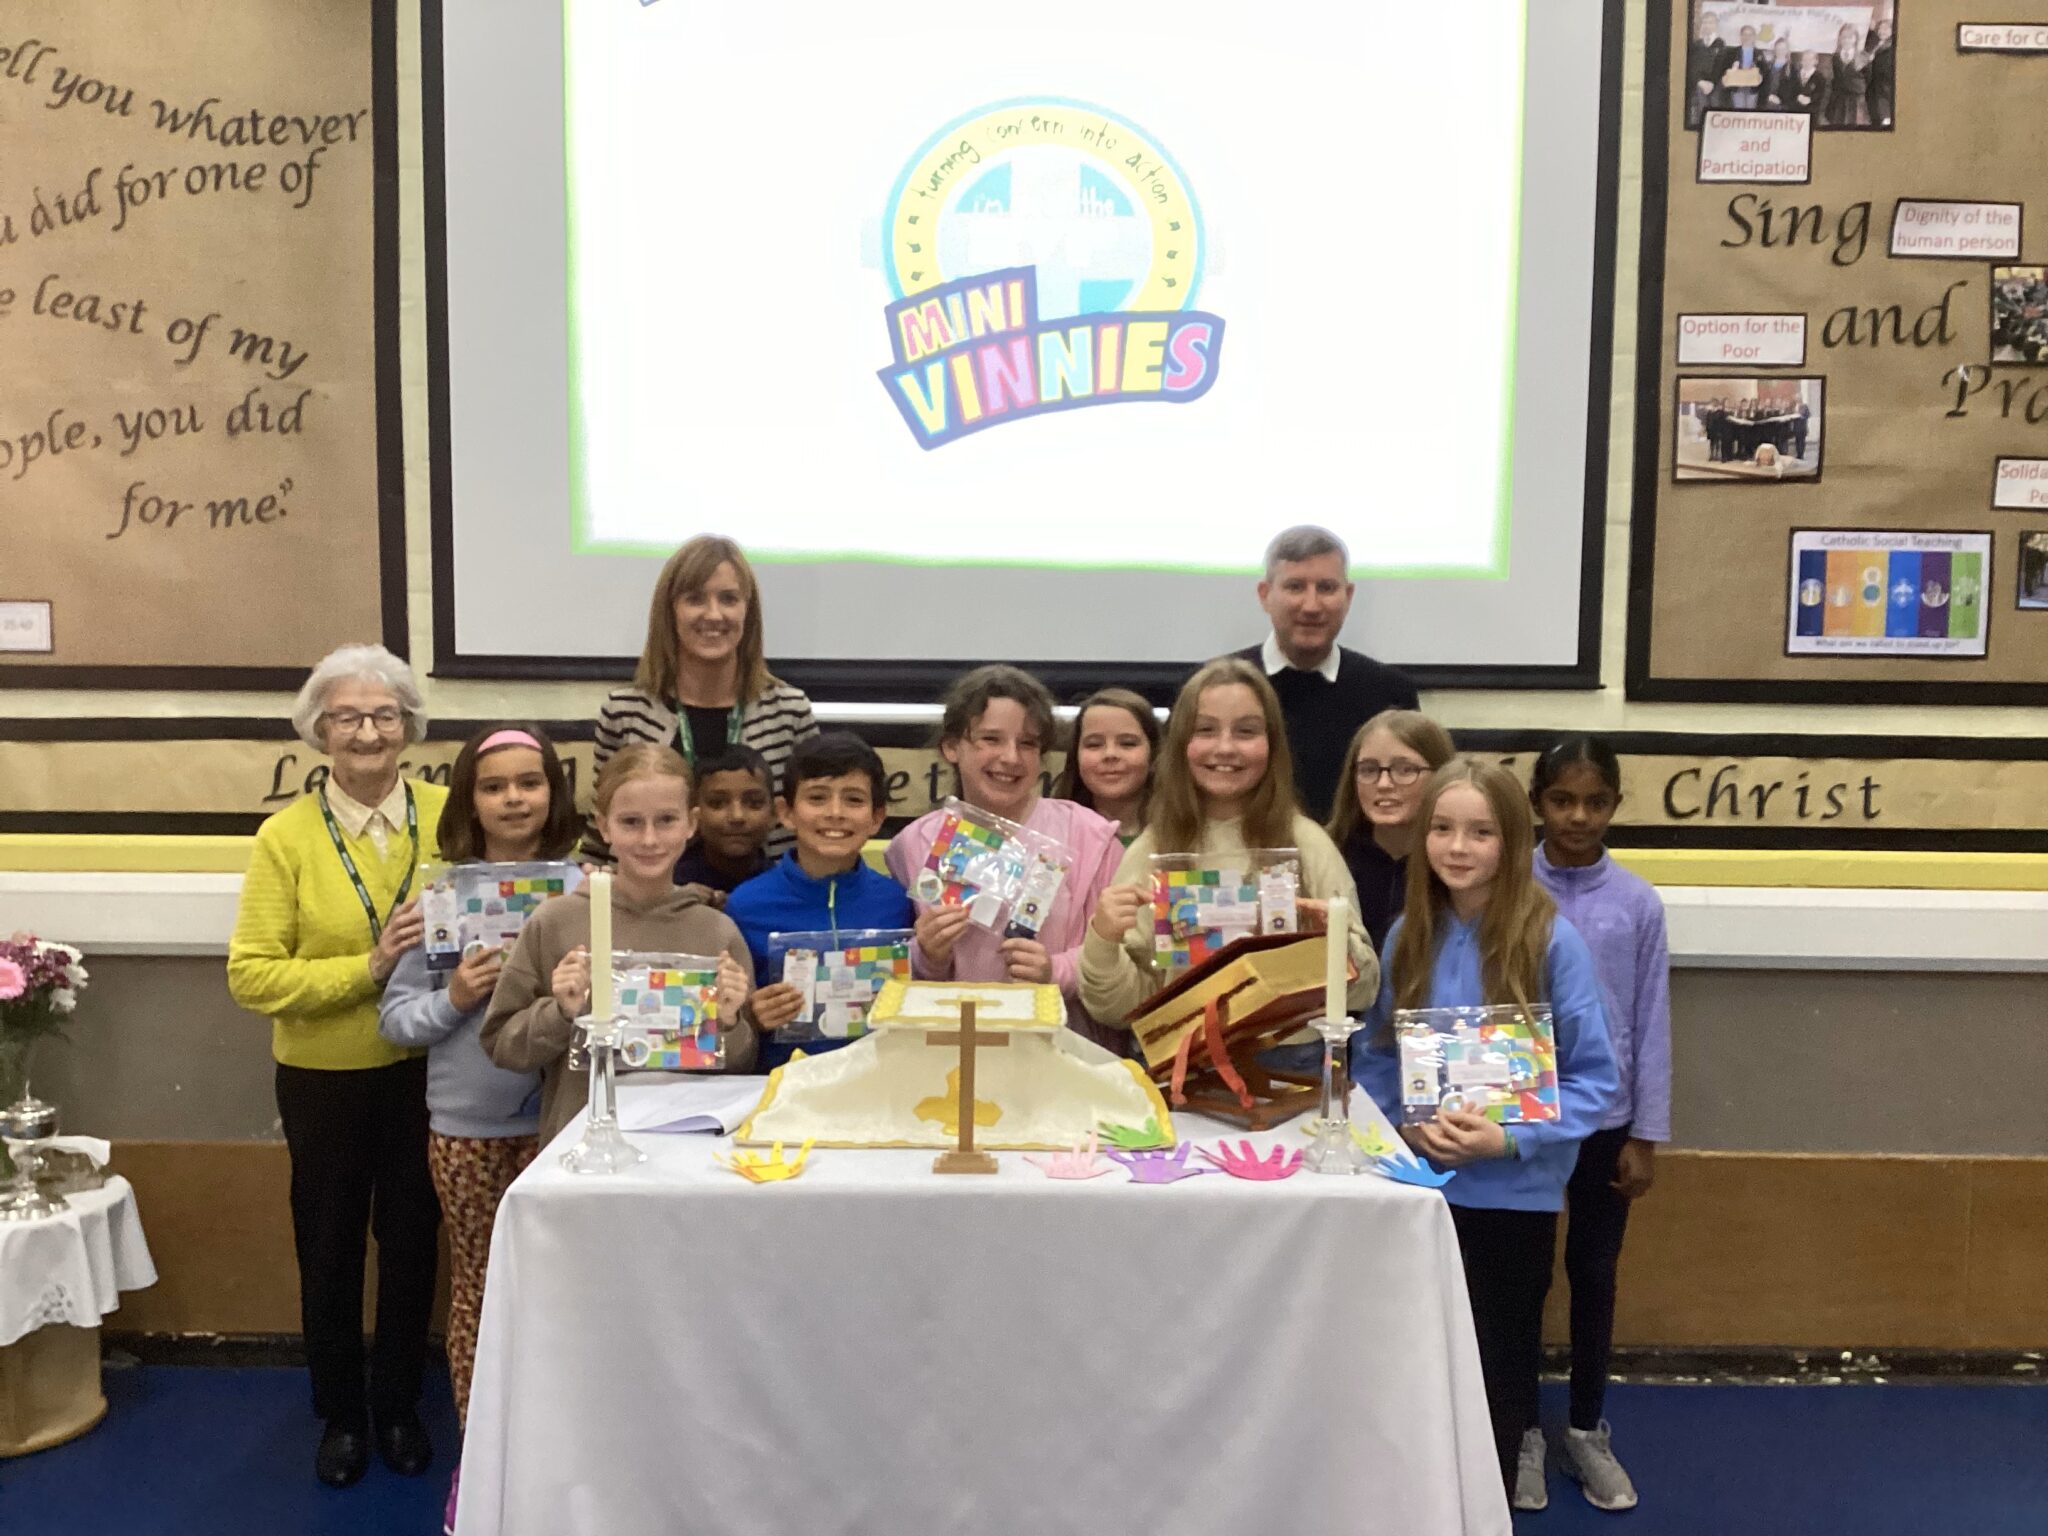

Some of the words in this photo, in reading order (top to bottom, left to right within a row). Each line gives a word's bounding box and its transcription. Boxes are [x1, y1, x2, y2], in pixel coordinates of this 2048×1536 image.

[1964, 30, 2001, 45] Care
[2006, 29, 2029, 45] for
[46, 67, 135, 117] you
[151, 98, 368, 147] whatever
[1710, 113, 1805, 134] Community
[910, 140, 982, 200] turning
[1080, 121, 1117, 150] into
[1124, 152, 1169, 205] action
[1701, 159, 1807, 177] Participation
[1739, 136, 1771, 152] and
[31, 167, 103, 237] did
[112, 164, 178, 232] for
[184, 161, 267, 195] one
[280, 147, 327, 209] of
[1904, 207, 1960, 226] Dignity
[1964, 208, 1982, 221] of
[1986, 210, 2014, 226] the
[1720, 192, 1872, 267] Sing
[1896, 231, 1953, 248] human
[1957, 236, 2015, 251] person
[33, 274, 148, 334] least
[166, 313, 221, 365] of
[229, 327, 309, 380] my
[898, 279, 1027, 363] MINI
[1683, 319, 1740, 337] Option
[1745, 317, 1768, 334] for
[1773, 318, 1801, 334] the
[1822, 280, 1968, 349] and
[894, 322, 1213, 436] VINNIES
[1723, 343, 1761, 359] Poor
[113, 404, 203, 457] you
[226, 387, 312, 438] did
[106, 481, 194, 539] for
[1821, 534, 1869, 546] Catholic
[1873, 535, 1908, 547] Social
[1911, 536, 1963, 549] Teaching
[1663, 764, 1882, 821] Christ
